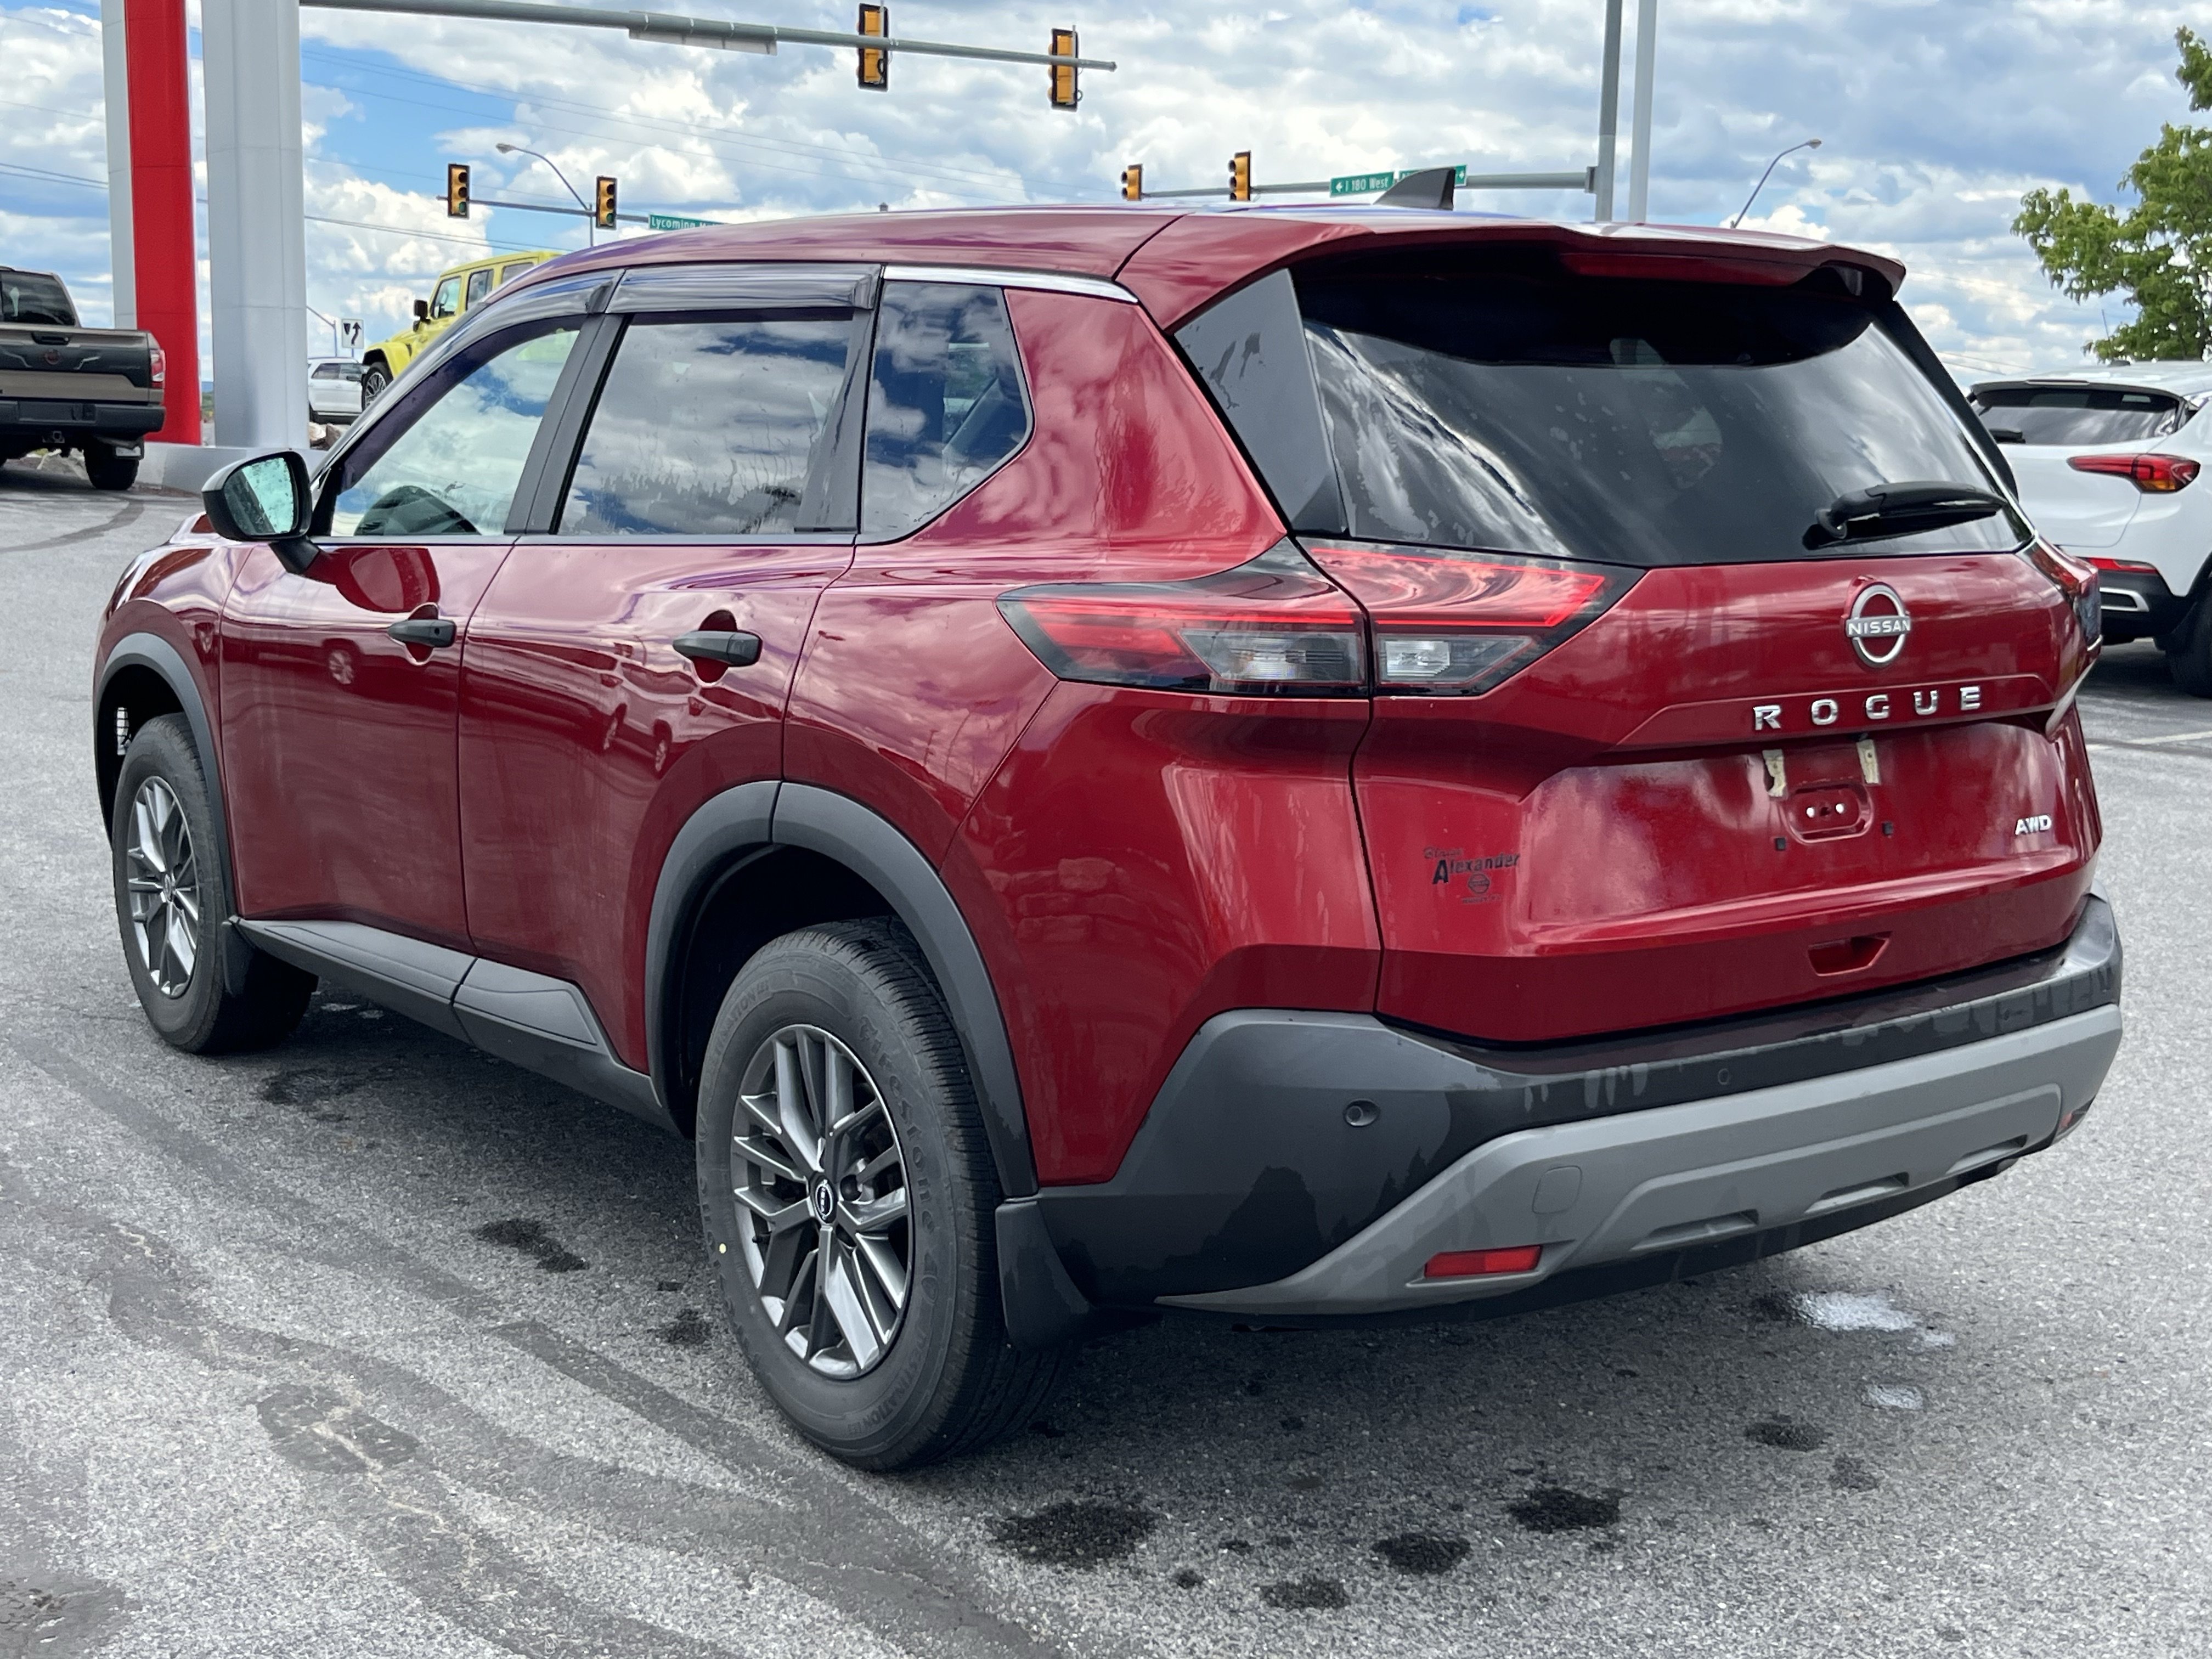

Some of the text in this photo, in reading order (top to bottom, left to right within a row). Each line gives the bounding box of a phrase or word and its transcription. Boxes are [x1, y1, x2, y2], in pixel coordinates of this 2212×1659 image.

[1351, 178, 1367, 191] 180
[1369, 177, 1389, 189] West
[651, 217, 696, 229] Lycoming
[1848, 617, 1911, 635] NISSAN
[1753, 686, 1981, 731] ROGUE
[2015, 815, 2052, 835] AWD
[1432, 853, 1520, 884] Alexander
